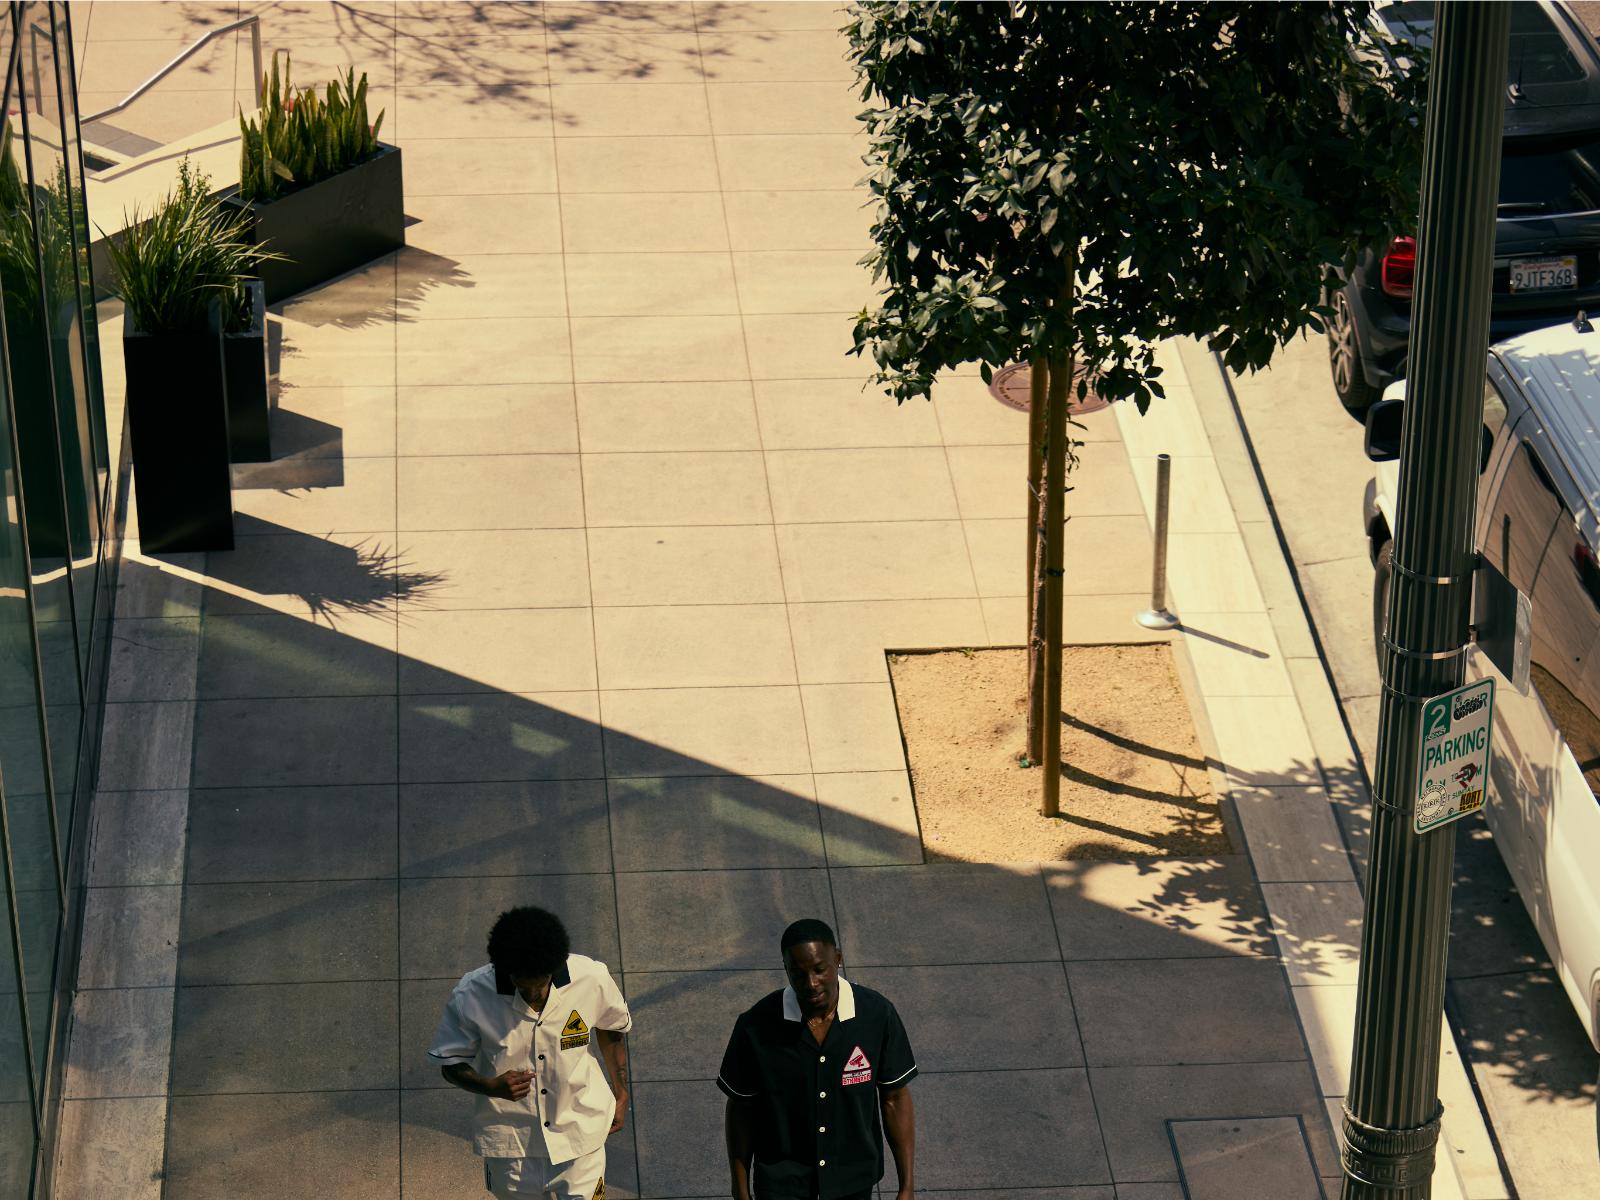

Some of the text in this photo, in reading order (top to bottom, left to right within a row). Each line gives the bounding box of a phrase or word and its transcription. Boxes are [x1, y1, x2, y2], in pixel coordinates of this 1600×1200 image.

[1515, 269, 1572, 289] 9JTF368
[1429, 704, 1446, 737] 2
[1426, 726, 1486, 771] PARKING
